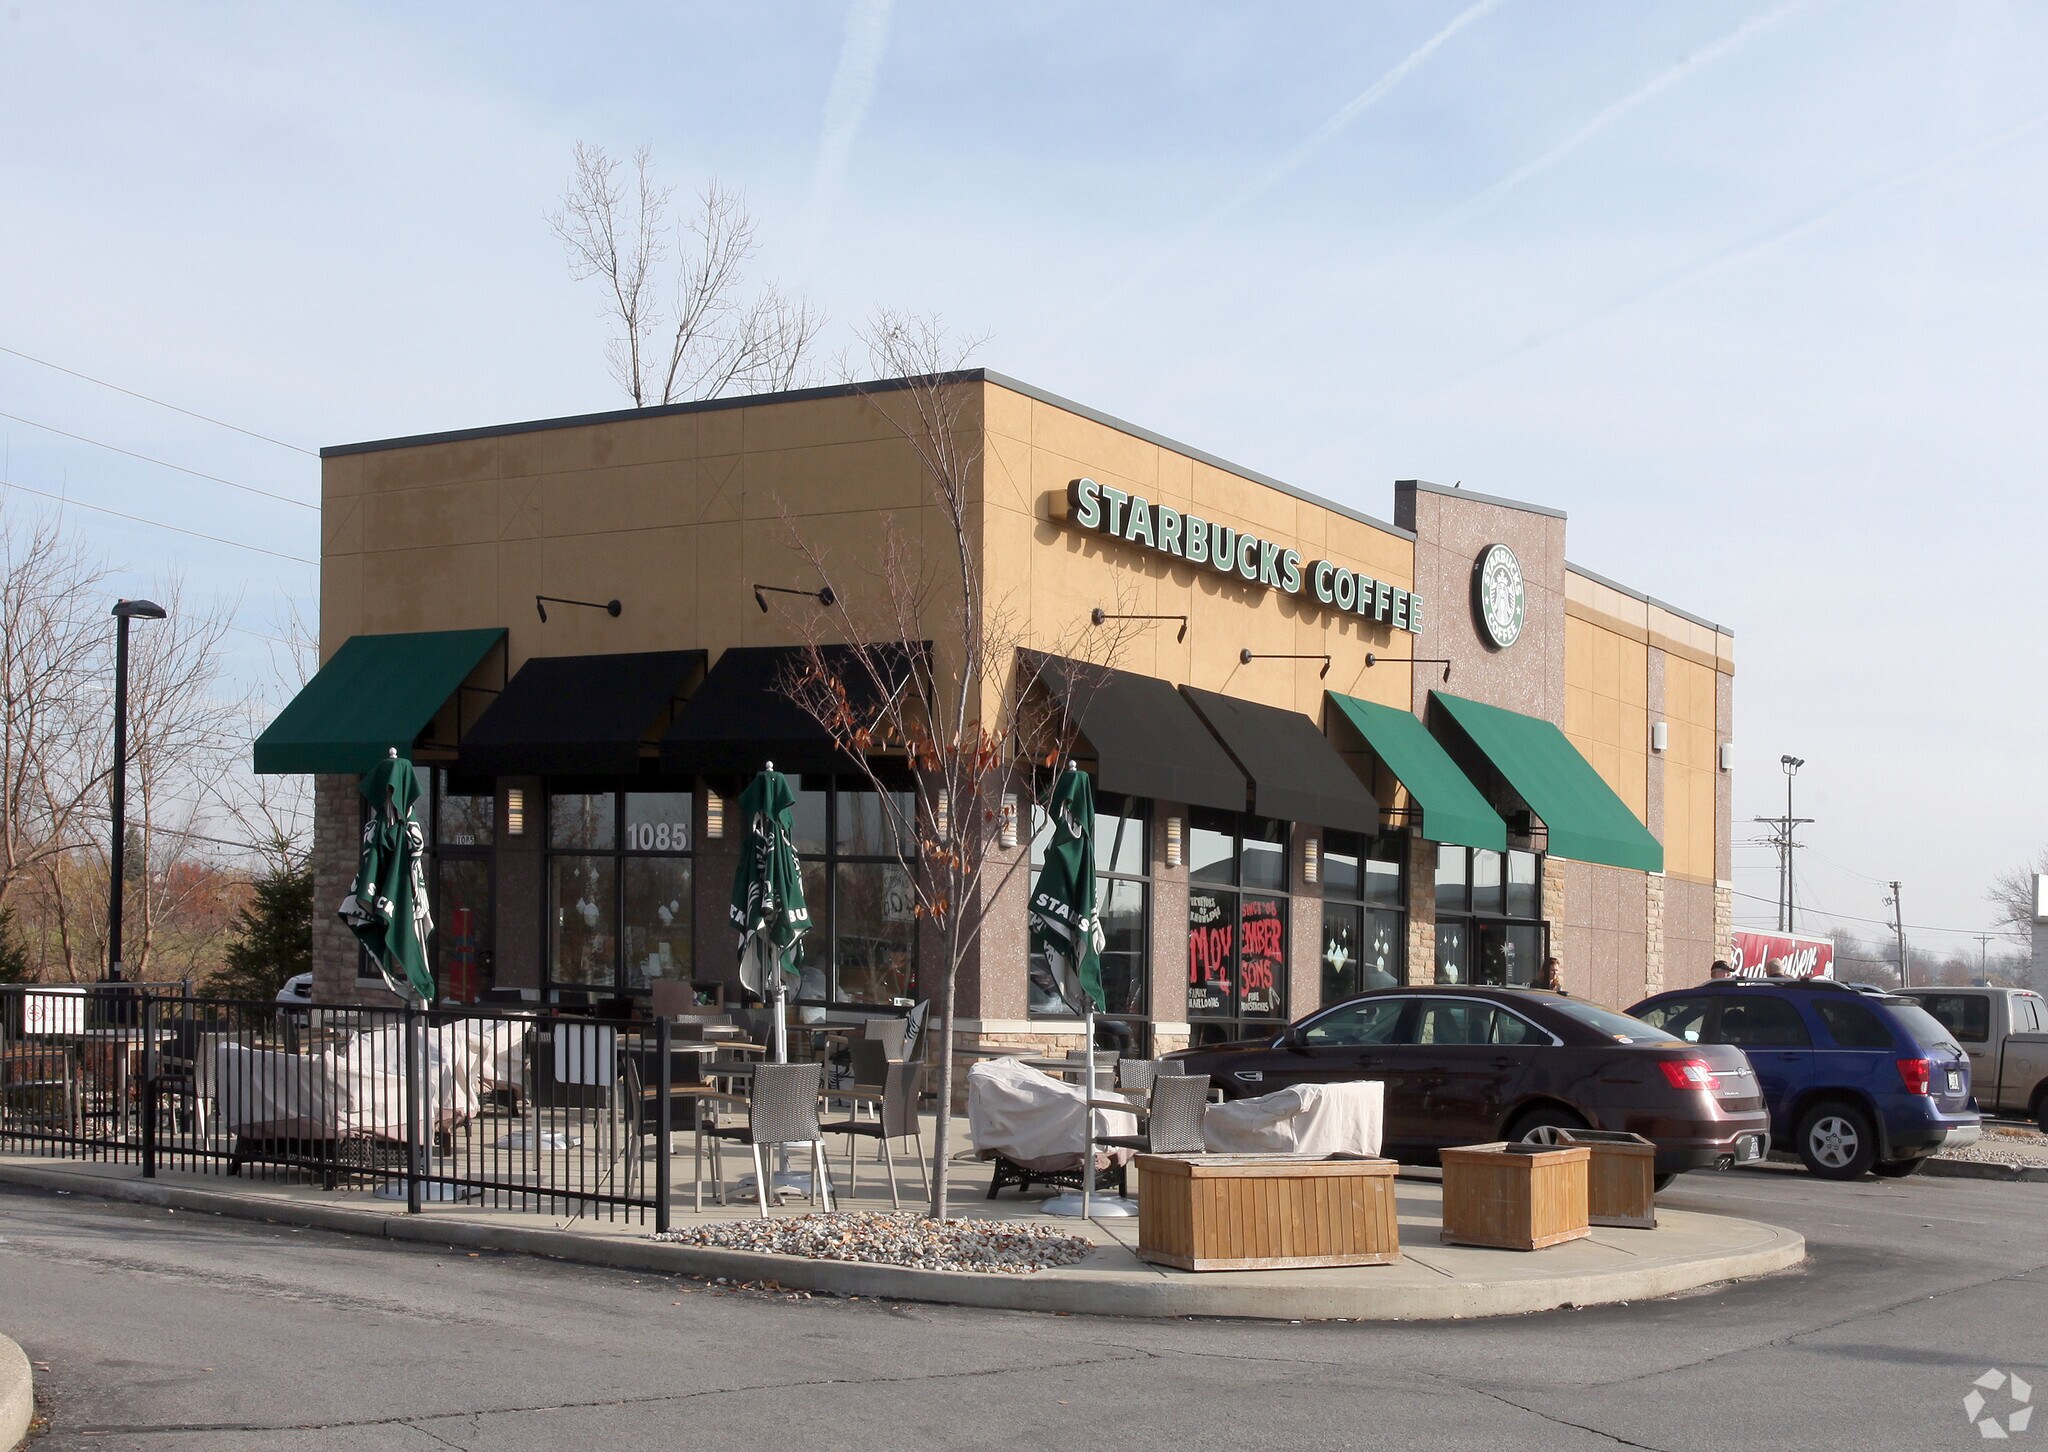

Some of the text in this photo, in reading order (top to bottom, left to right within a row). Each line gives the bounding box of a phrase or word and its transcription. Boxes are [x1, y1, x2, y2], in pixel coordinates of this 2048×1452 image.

[1077, 477, 1424, 635] STARBUCKS COFFEE
[1484, 549, 1522, 596] STARBUCKS
[1488, 612, 1517, 641] COFFEE
[628, 822, 687, 851] 1085
[1241, 959, 1274, 998] SONS
